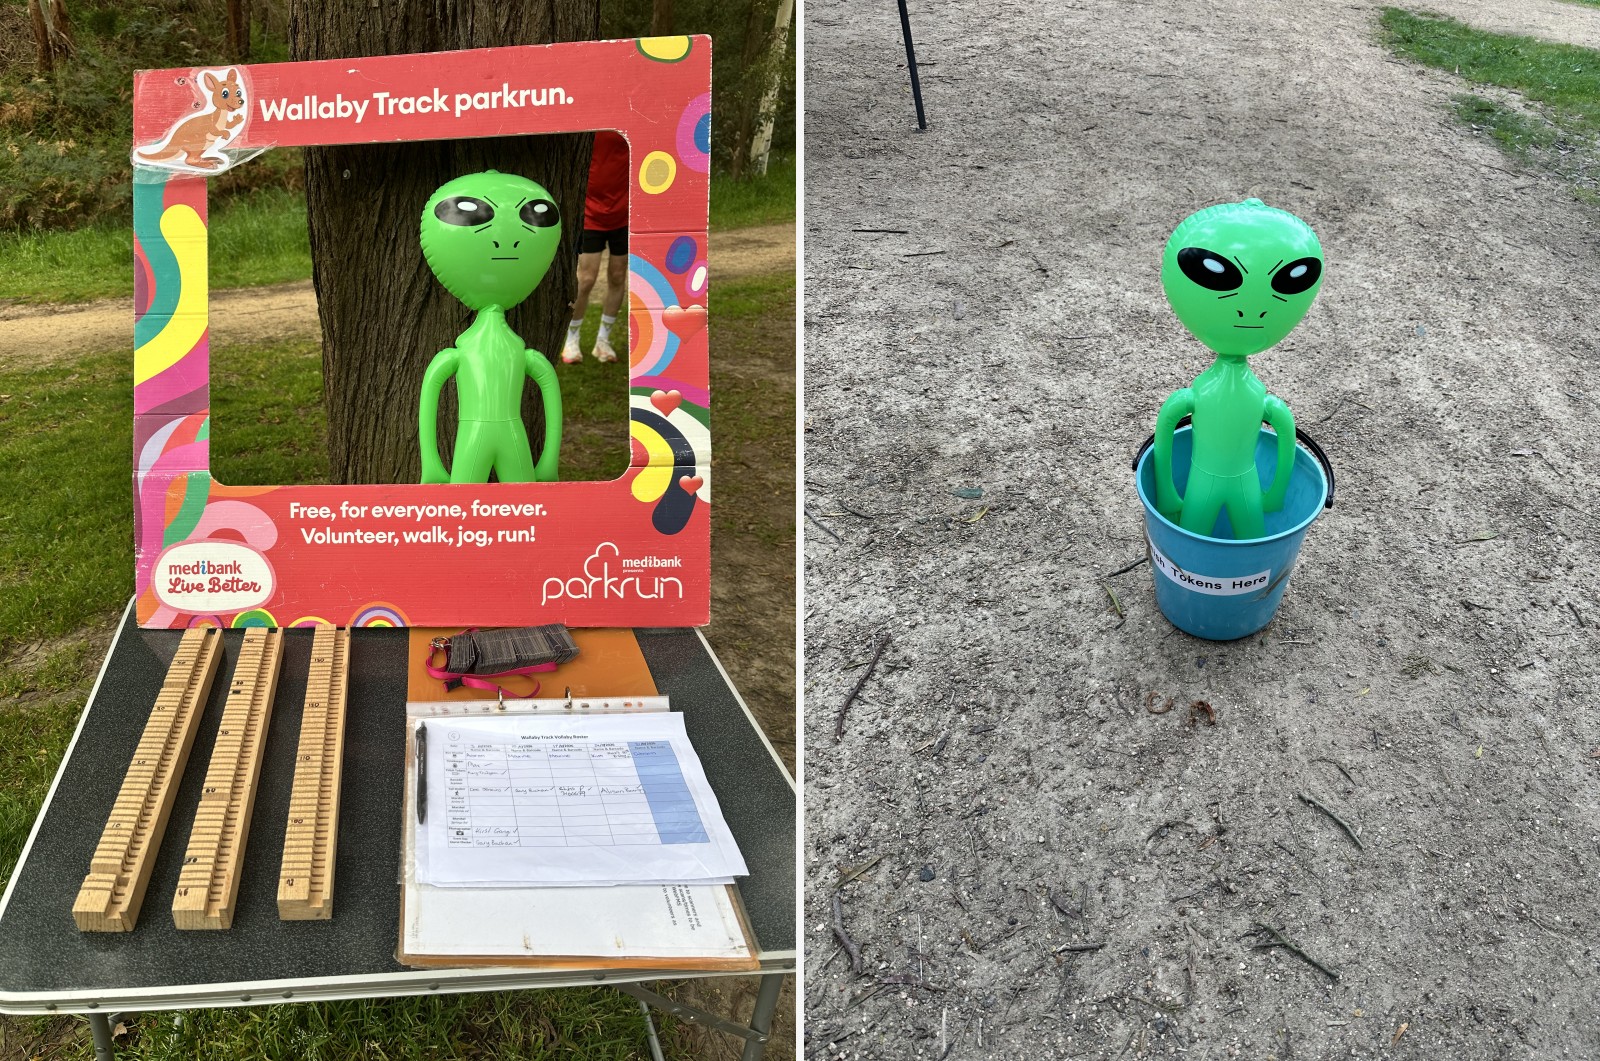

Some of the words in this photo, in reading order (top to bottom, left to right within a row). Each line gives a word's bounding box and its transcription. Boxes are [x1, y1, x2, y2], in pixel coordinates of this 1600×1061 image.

[259, 94, 370, 123] Wallaby
[373, 87, 450, 116] Track
[455, 82, 574, 118] parkrun.
[289, 502, 336, 521] Free,
[340, 501, 368, 518] for
[371, 503, 467, 522] everyone,
[471, 499, 547, 517] forever.
[300, 527, 399, 547] Volunteer,
[402, 527, 453, 546] walk,
[456, 525, 493, 548] jog,
[497, 526, 535, 543] run!
[168, 560, 242, 575] medibank
[622, 556, 682, 568] medibank
[167, 577, 205, 594] Live
[208, 576, 262, 593] Better
[541, 561, 683, 606] parkrun
[1171, 567, 1222, 590] Tokens
[1232, 575, 1267, 590] Here
